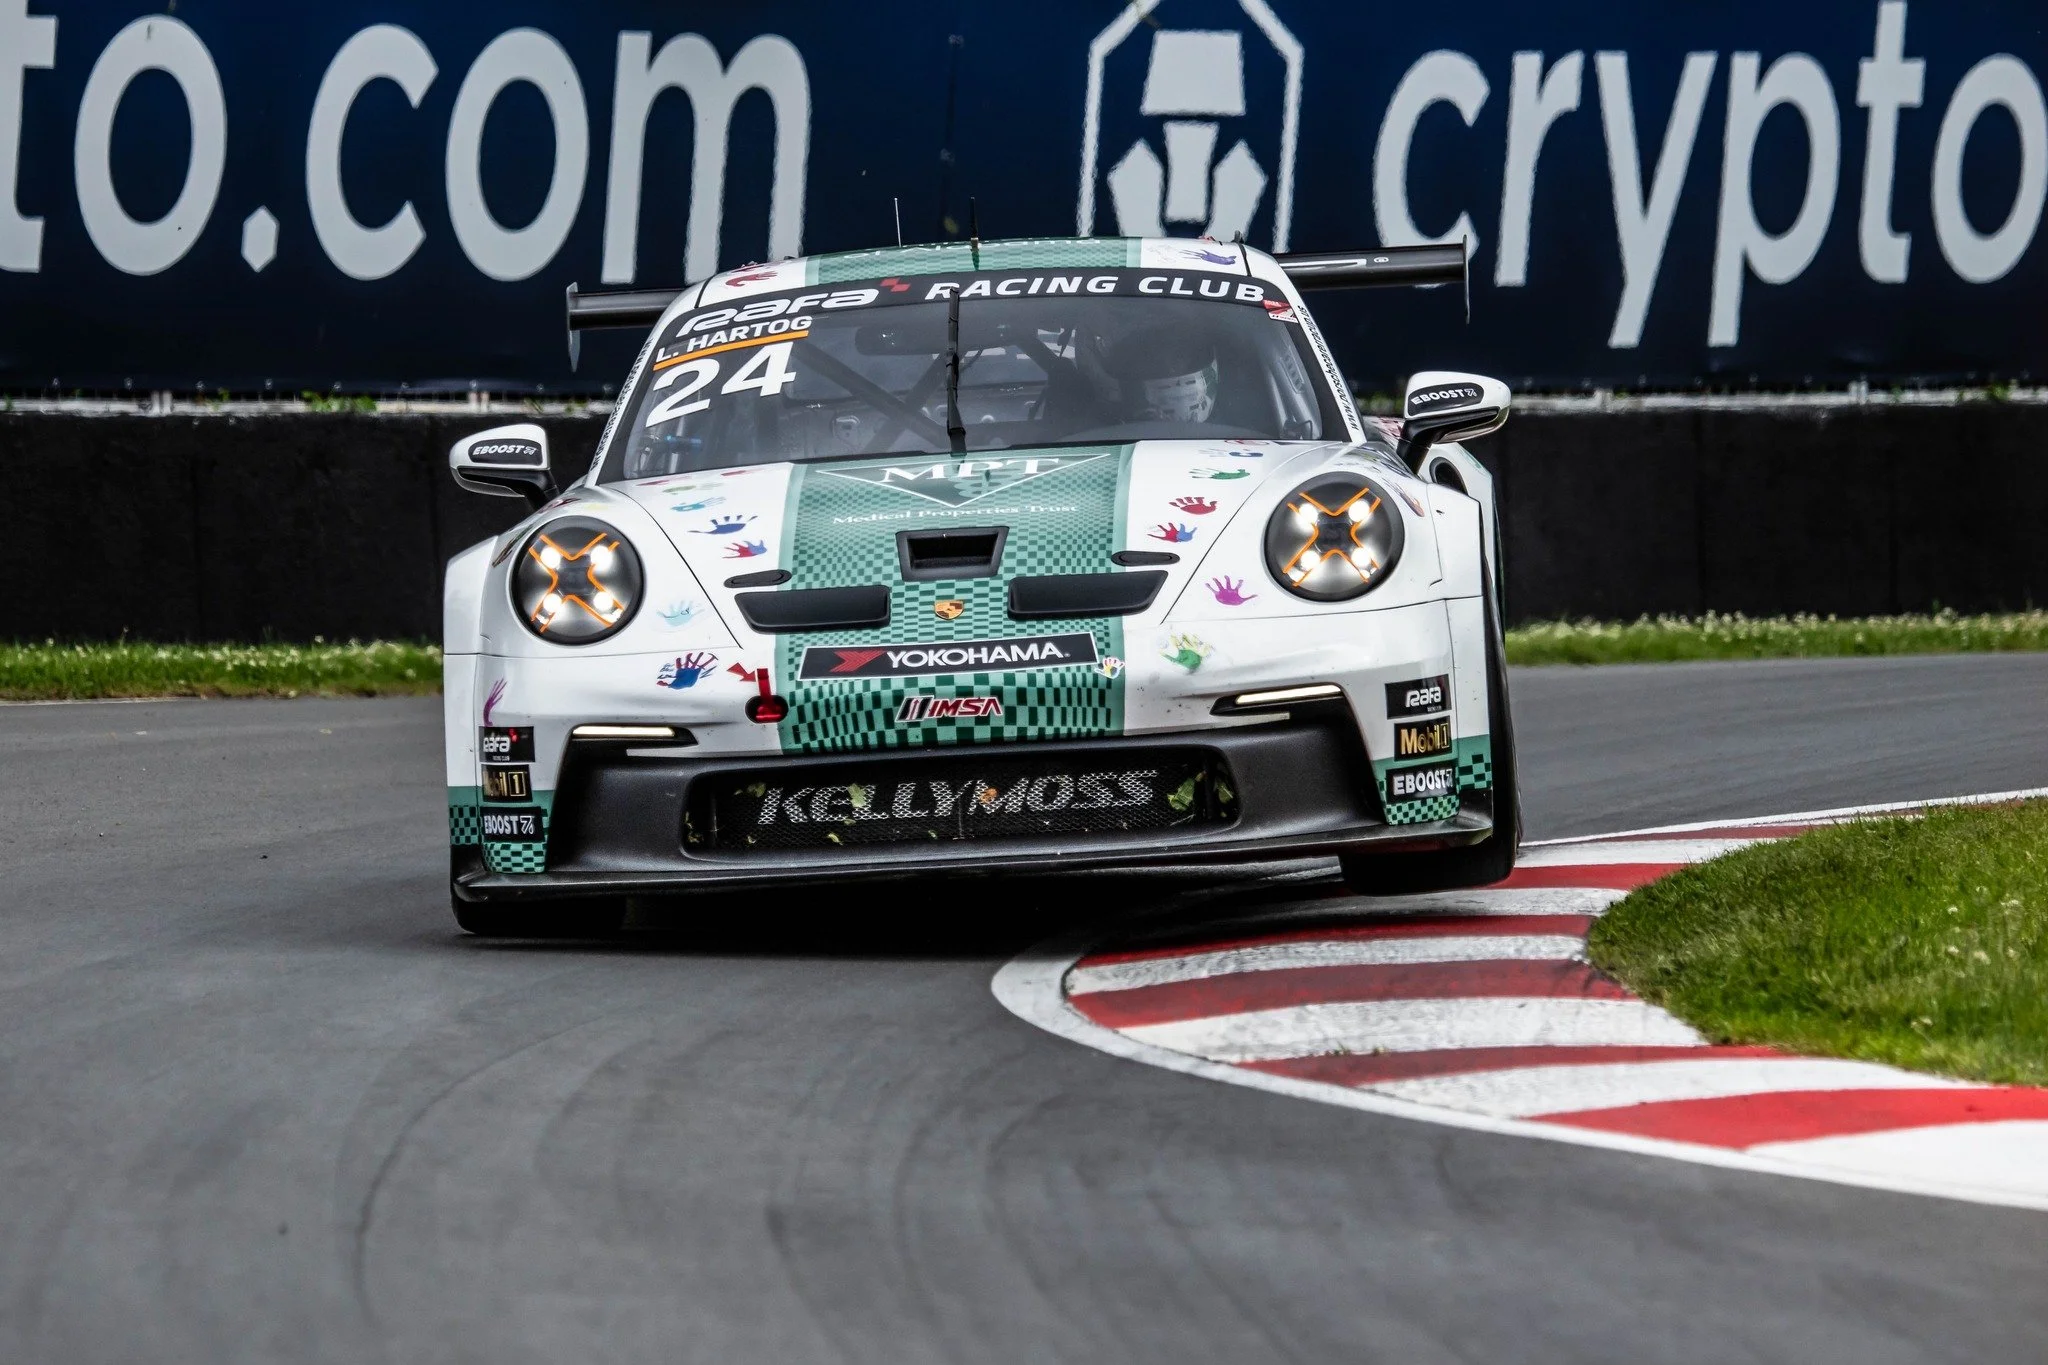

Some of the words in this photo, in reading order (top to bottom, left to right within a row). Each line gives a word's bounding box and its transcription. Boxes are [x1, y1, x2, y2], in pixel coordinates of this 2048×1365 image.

[1373, 0, 2048, 348] crypto
[925, 276, 1118, 300] RACING
[1138, 277, 1265, 302] CLUB
[656, 347, 678, 362] L.
[687, 316, 812, 351] HARTOG
[646, 341, 797, 428] 24
[1411, 388, 1465, 405] EBOOST
[472, 445, 524, 456] EBOOST
[879, 458, 1060, 483] MPT
[832, 510, 911, 525] Medical
[917, 506, 1019, 517] Properties
[1025, 505, 1079, 514] Trust
[886, 642, 1065, 668] YOKOHAMA
[927, 697, 1003, 718] IMSA
[1401, 723, 1441, 755] Mobil
[1393, 769, 1447, 796] EBOOST
